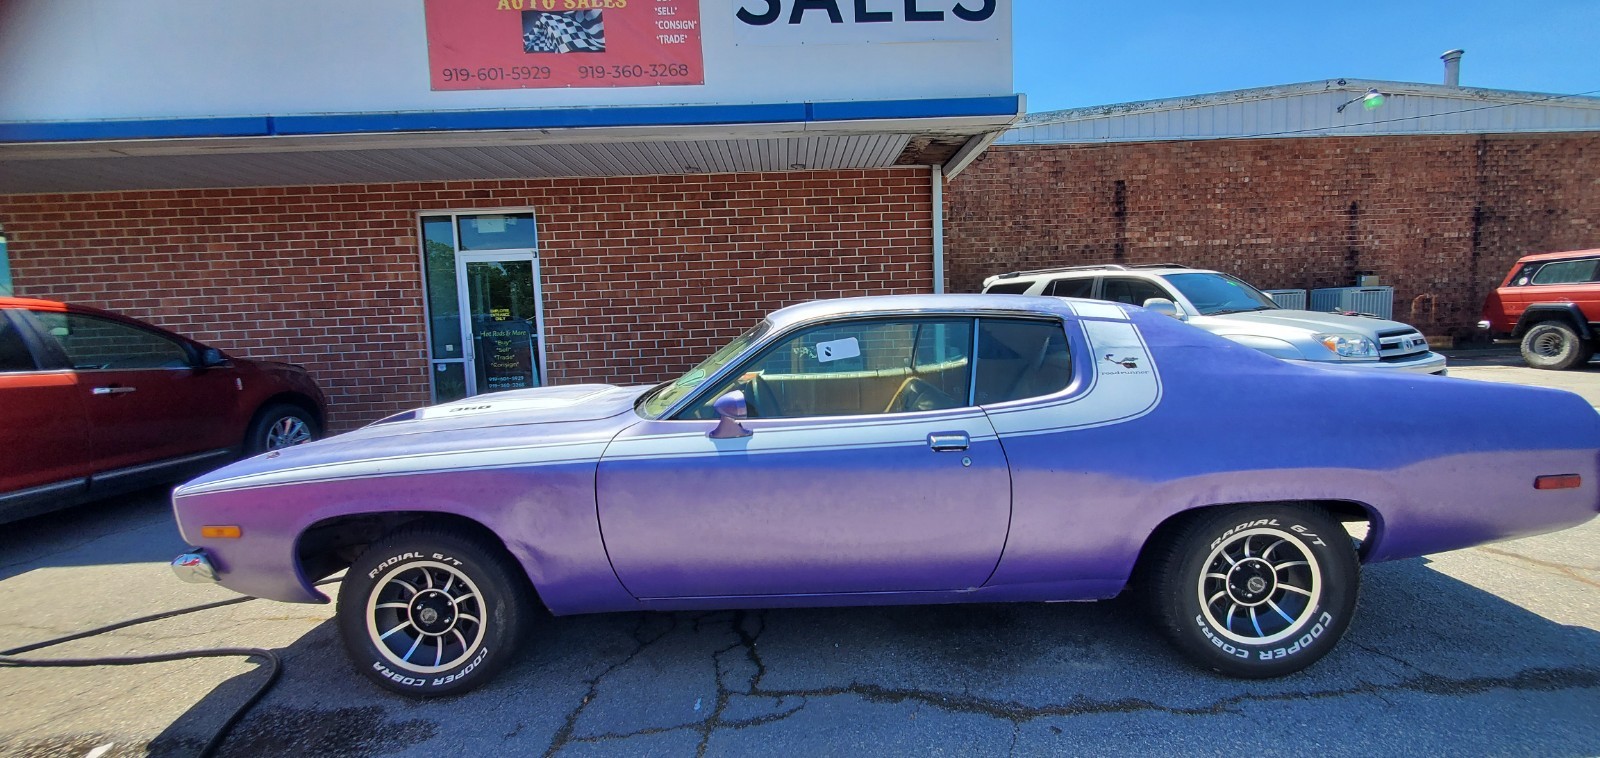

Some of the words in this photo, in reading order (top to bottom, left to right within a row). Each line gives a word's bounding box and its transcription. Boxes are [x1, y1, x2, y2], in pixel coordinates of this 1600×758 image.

[442, 66, 551, 82] 919-601-5929
[578, 63, 689, 79] 919-360-3268
[1210, 518, 1281, 550] RADIAL
[1290, 524, 1327, 547] G/T
[368, 551, 424, 579] RADIAL
[432, 552, 463, 566] G/T
[1195, 614, 1250, 659] COBRA
[1259, 611, 1333, 660] COOPER
[373, 661, 426, 687] COBRA
[432, 647, 488, 686] COOPER
